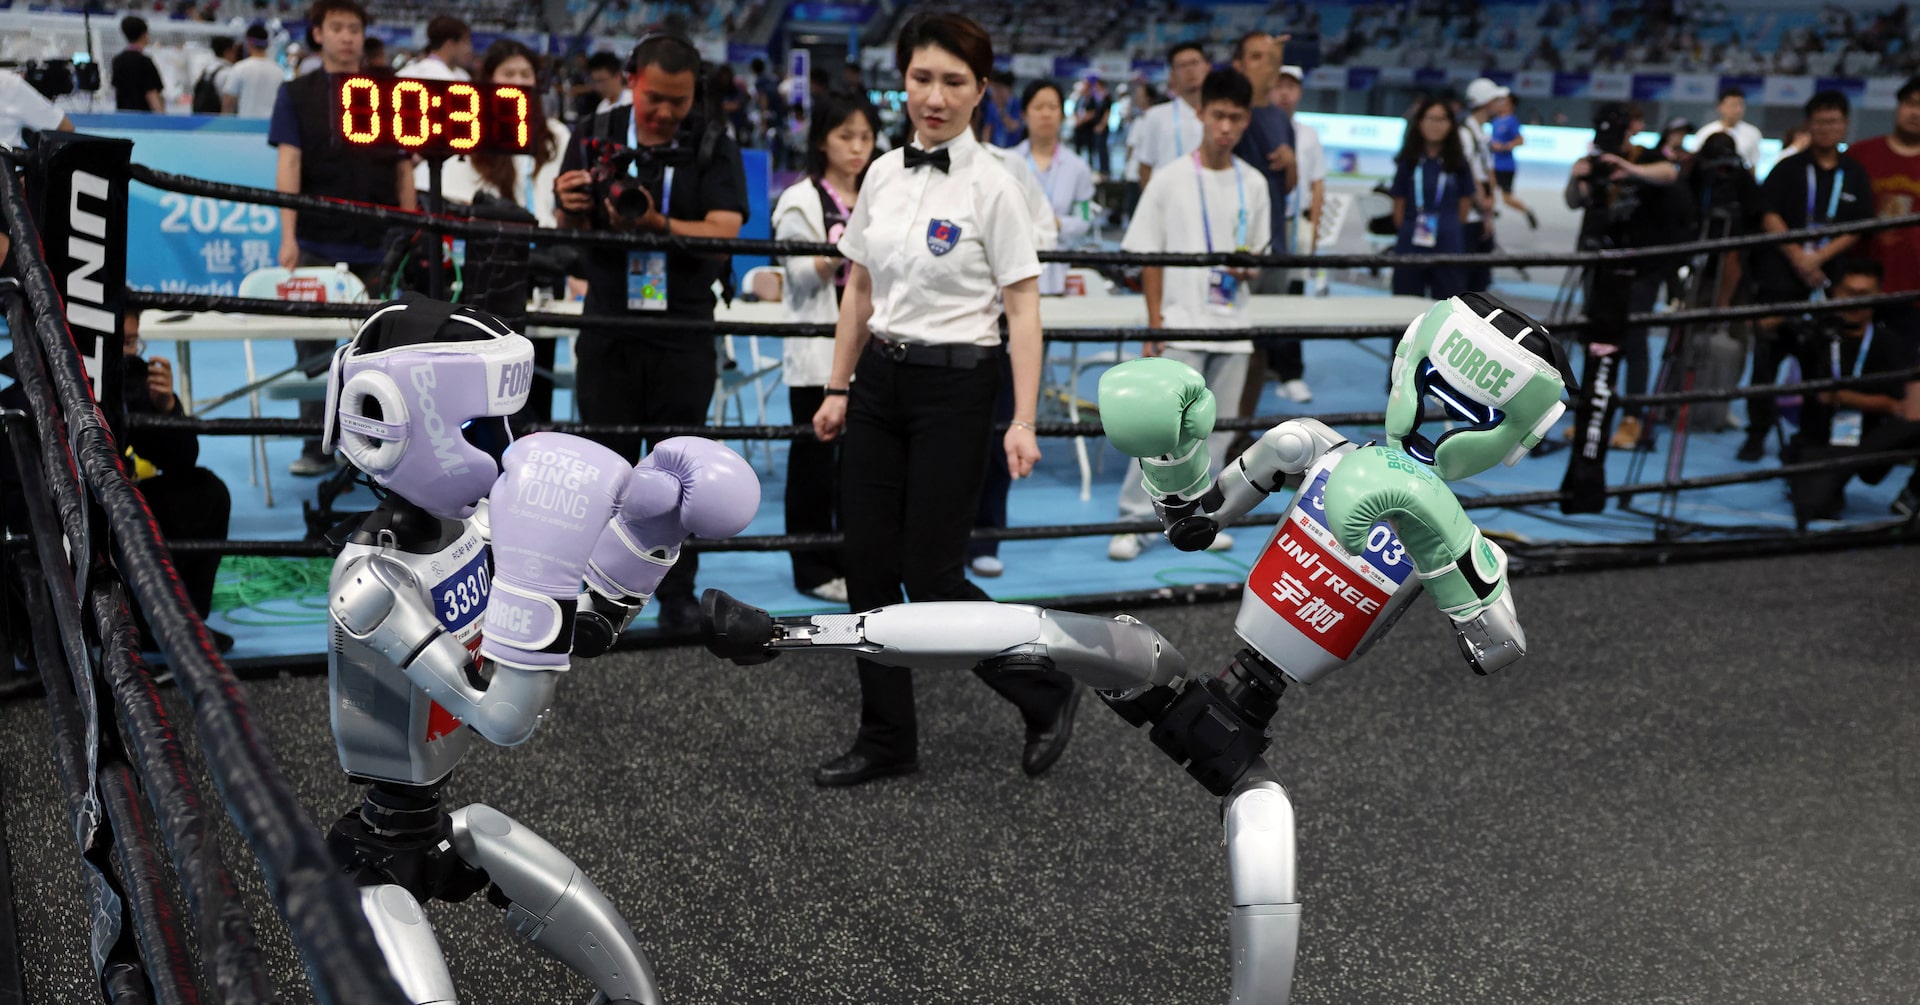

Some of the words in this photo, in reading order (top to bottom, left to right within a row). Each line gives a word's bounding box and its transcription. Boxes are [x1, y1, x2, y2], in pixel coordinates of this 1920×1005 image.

[342, 78, 527, 149] 00:37
[159, 194, 278, 234] 2025
[201, 239, 273, 273] 世界
[497, 360, 533, 398] FOR
[1438, 328, 1515, 398] FORCE
[520, 462, 582, 492] GING
[526, 449, 601, 481] BOXER
[517, 476, 589, 519] YOUNG
[1277, 532, 1380, 615] UNITREE
[488, 598, 533, 635] ORCE
[1271, 570, 1345, 634] 宇树
